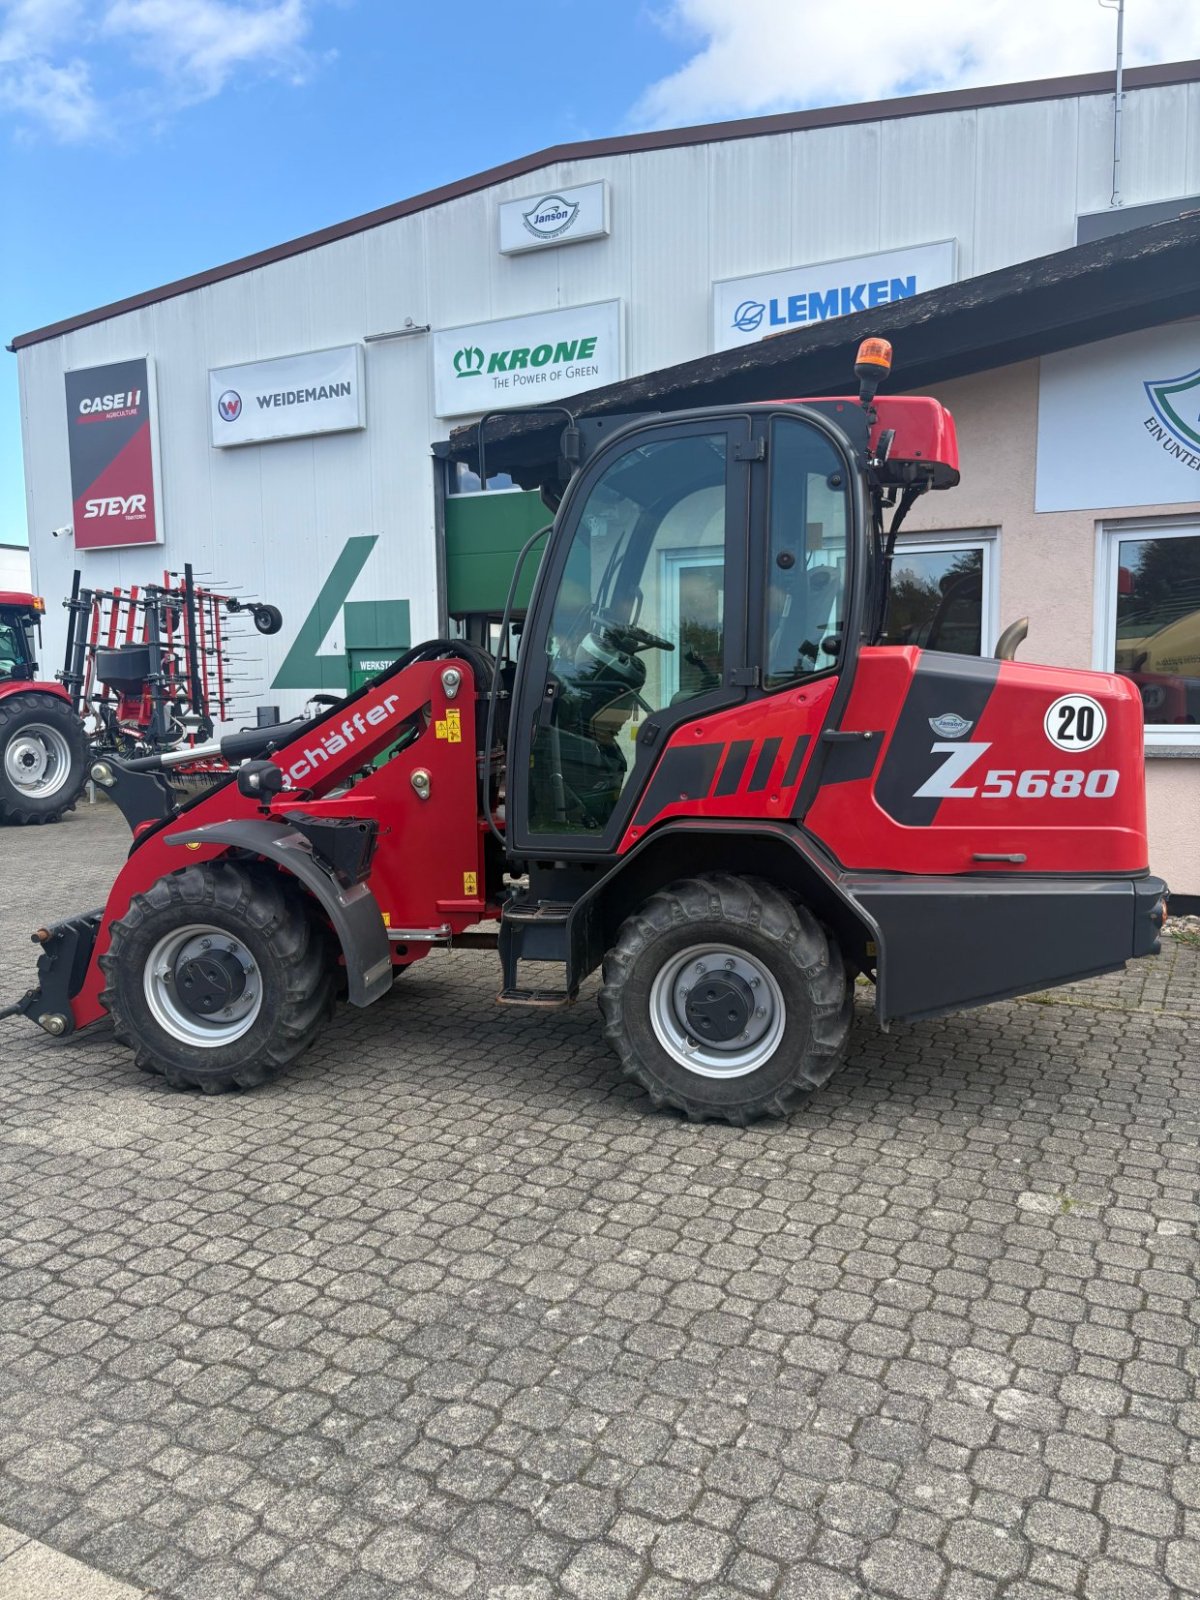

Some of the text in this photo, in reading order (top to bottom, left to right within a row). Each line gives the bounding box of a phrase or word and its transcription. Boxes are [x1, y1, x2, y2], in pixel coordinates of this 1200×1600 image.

[533, 210, 568, 224] Janson
[769, 275, 917, 326] LEMKEN
[487, 336, 598, 374] KRONE
[256, 381, 351, 409] WEIDEMANN
[1143, 416, 1167, 442] EIN
[1163, 437, 1200, 471] UNTE
[83, 494, 147, 519] STEYR
[1057, 705, 1095, 741] 20
